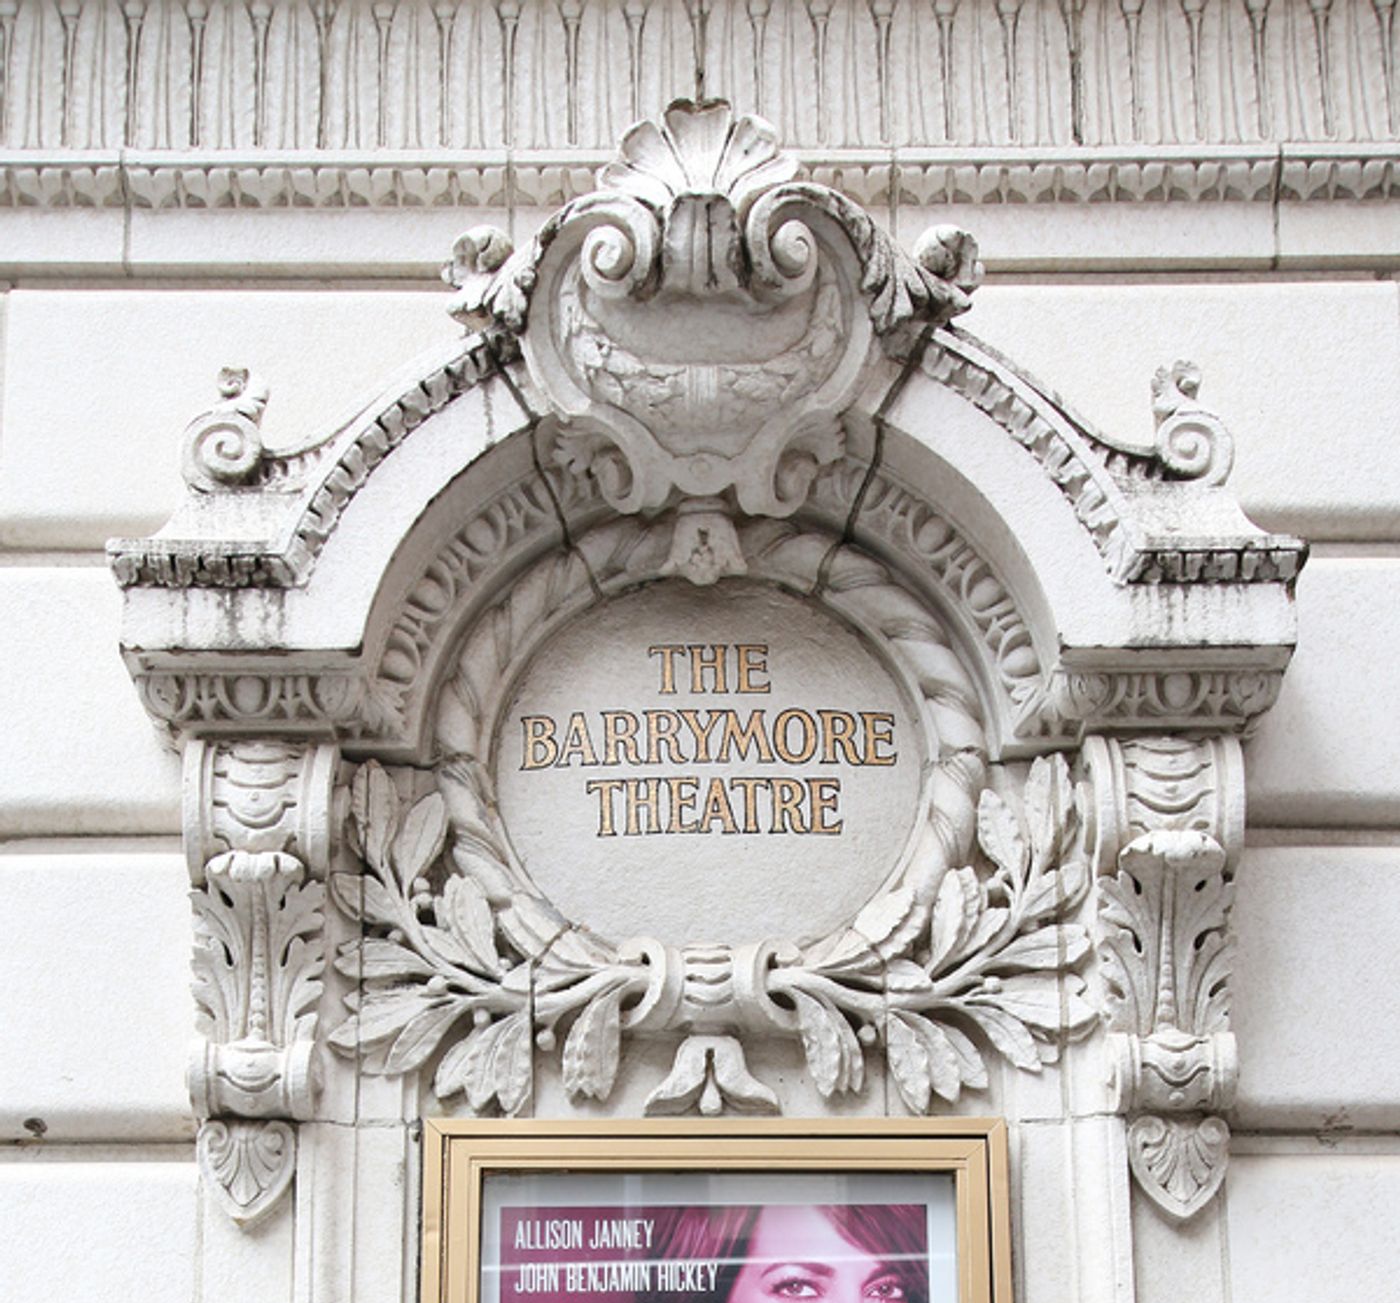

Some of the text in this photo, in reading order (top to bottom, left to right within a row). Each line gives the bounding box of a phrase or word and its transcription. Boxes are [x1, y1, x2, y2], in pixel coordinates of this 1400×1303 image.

[648, 643, 772, 694] THE
[519, 708, 898, 771] BARRYMORE
[586, 777, 844, 837] THEATRE
[514, 1219, 655, 1250] ALLISON JANNEY
[514, 1261, 719, 1293] JOHN BENJAMIN HICKEY
